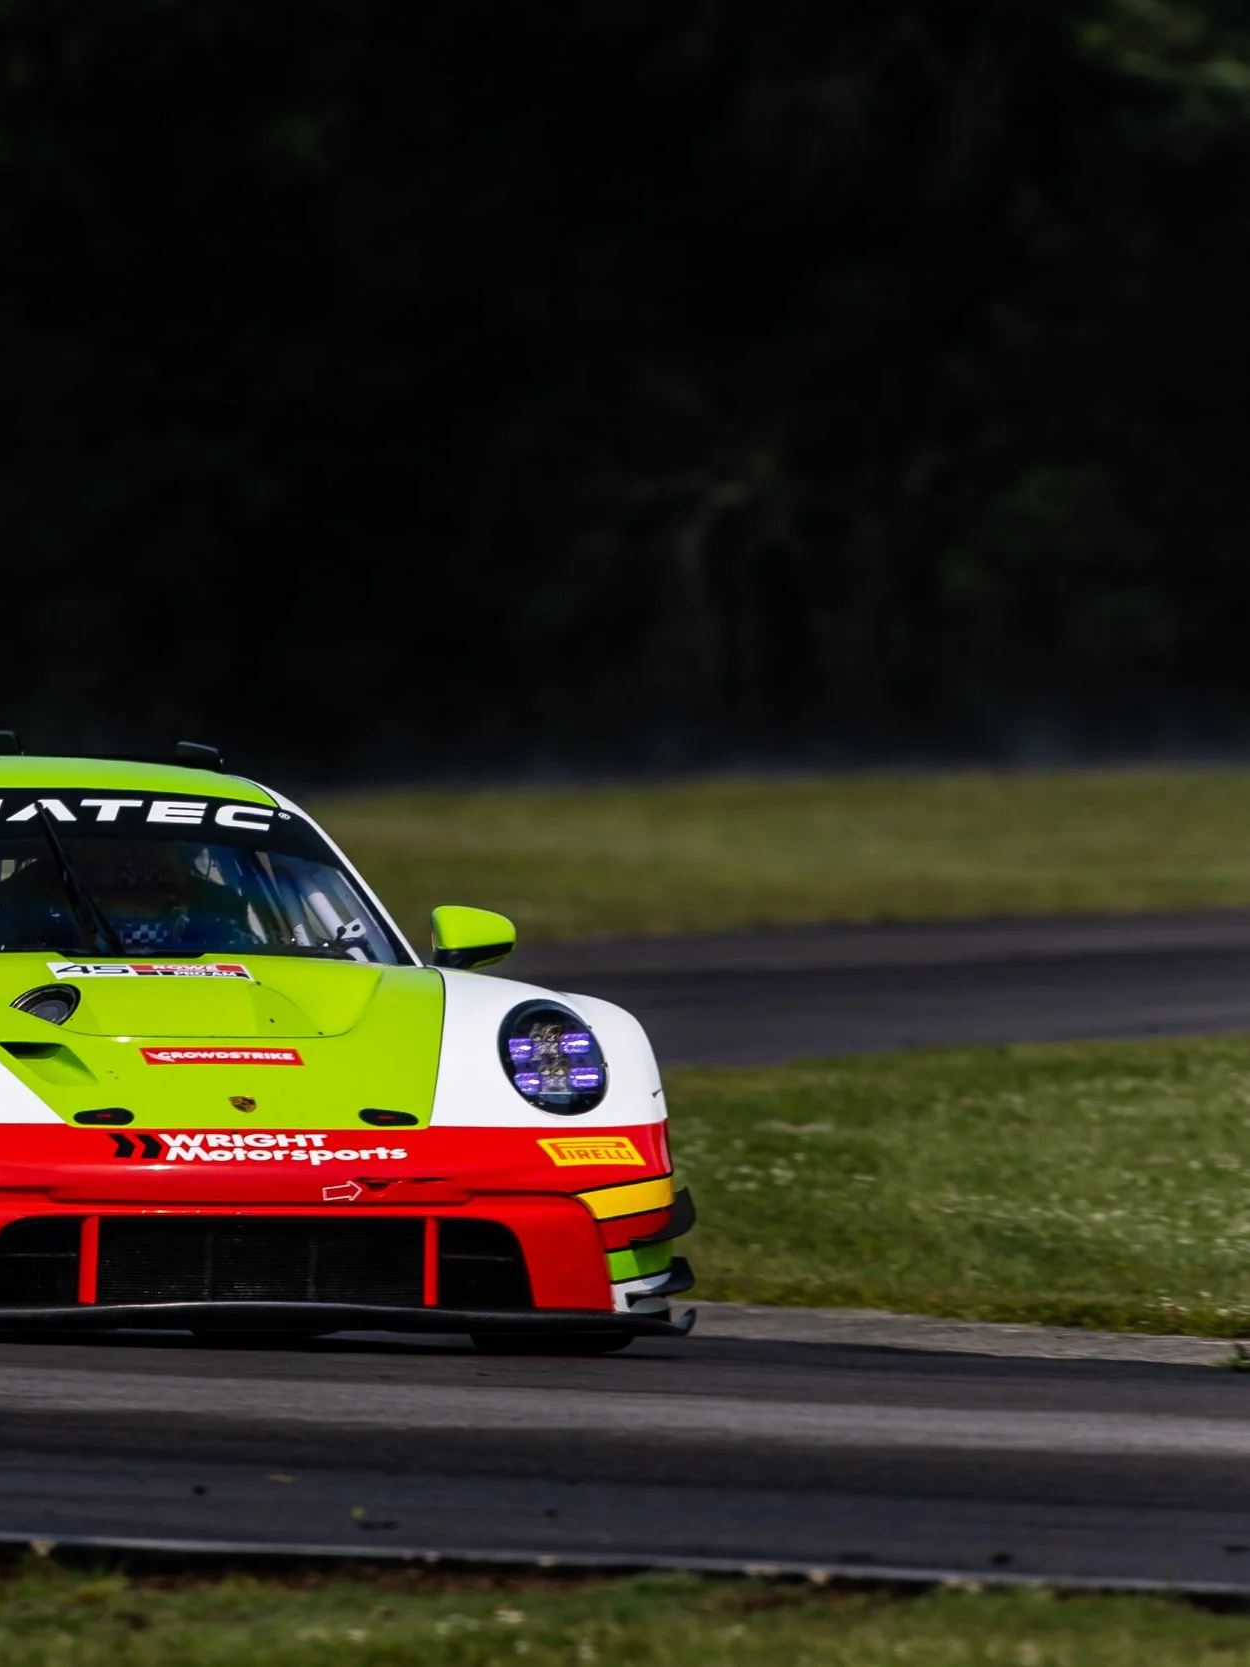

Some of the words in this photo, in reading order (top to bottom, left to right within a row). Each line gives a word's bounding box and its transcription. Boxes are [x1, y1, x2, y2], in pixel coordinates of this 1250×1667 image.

[56, 964, 130, 975] 45
[157, 1051, 295, 1061] CROWDSTRIKE
[158, 1133, 328, 1147] WRIGHT
[165, 1146, 408, 1166] Motorsports
[547, 1141, 635, 1160] PIRELLI
